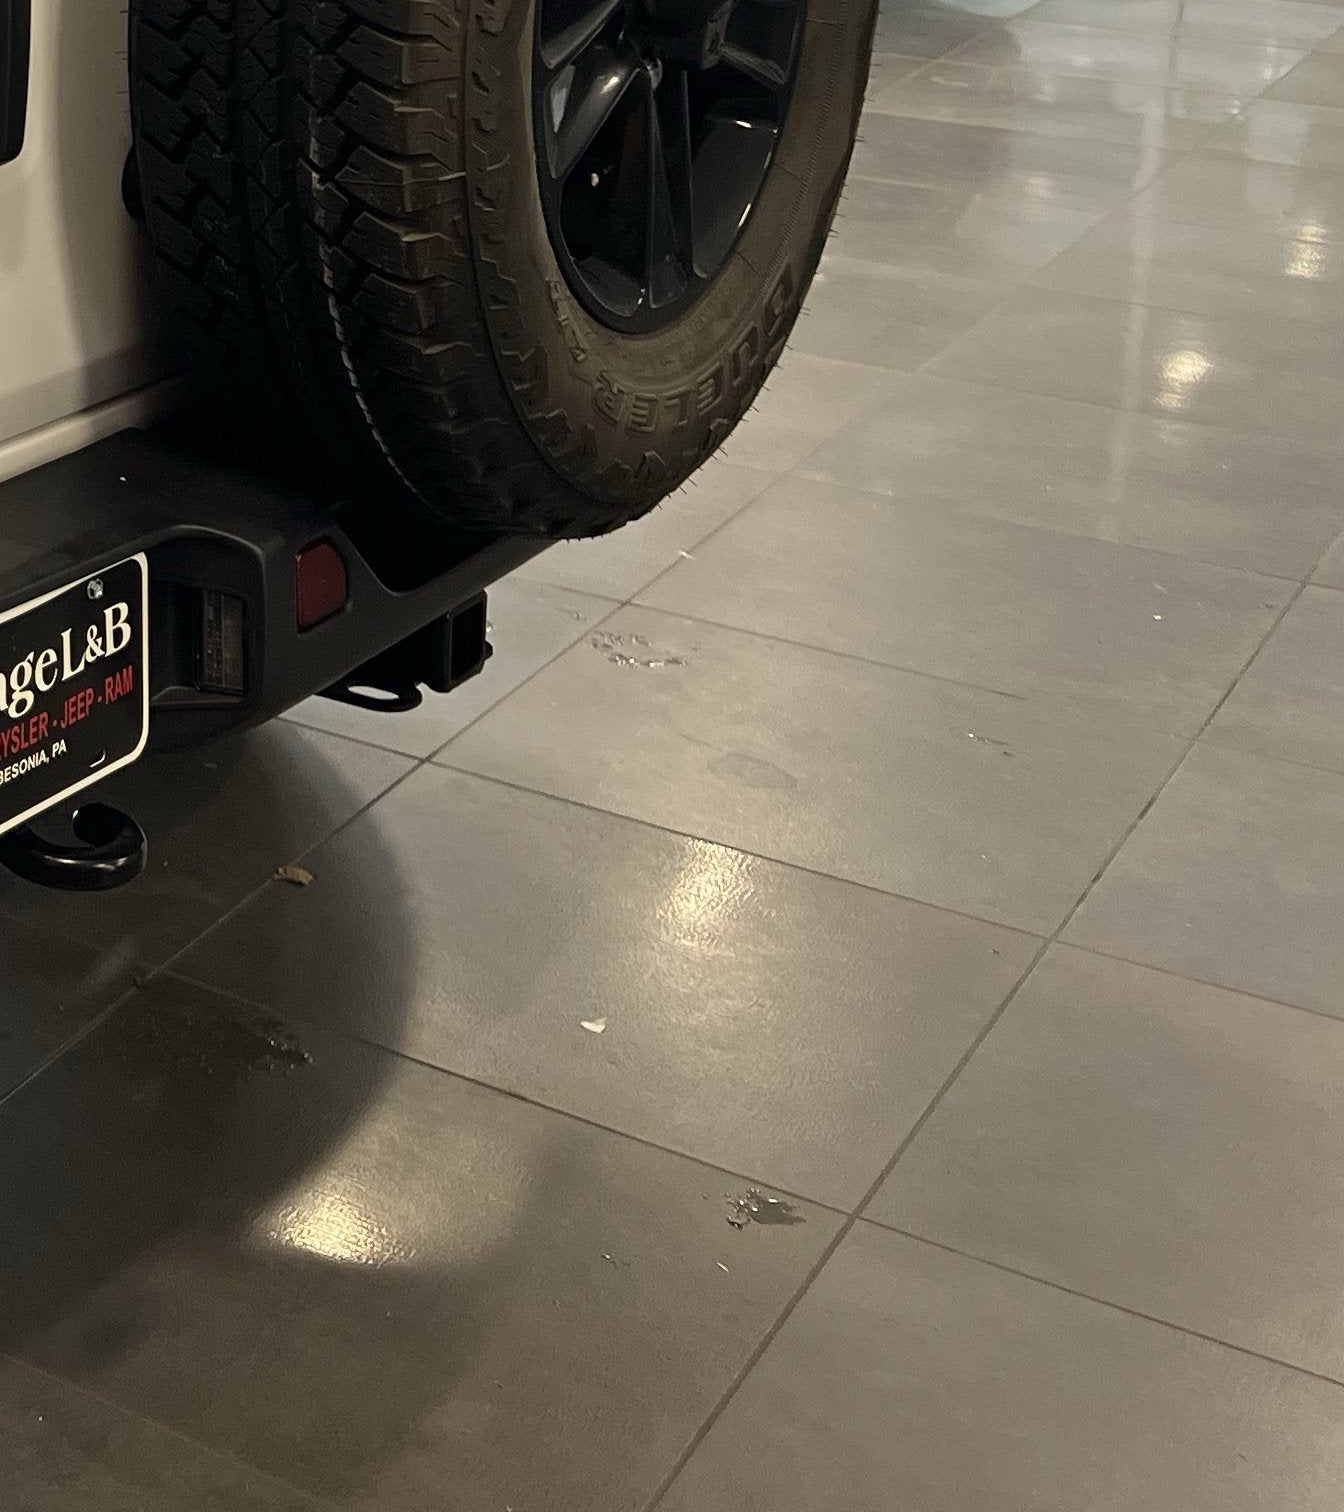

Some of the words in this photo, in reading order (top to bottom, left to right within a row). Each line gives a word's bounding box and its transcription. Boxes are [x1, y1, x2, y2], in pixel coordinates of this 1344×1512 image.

[60, 688, 94, 729] JEEP
[105, 665, 134, 705] RAM
[52, 739, 67, 759] PA
